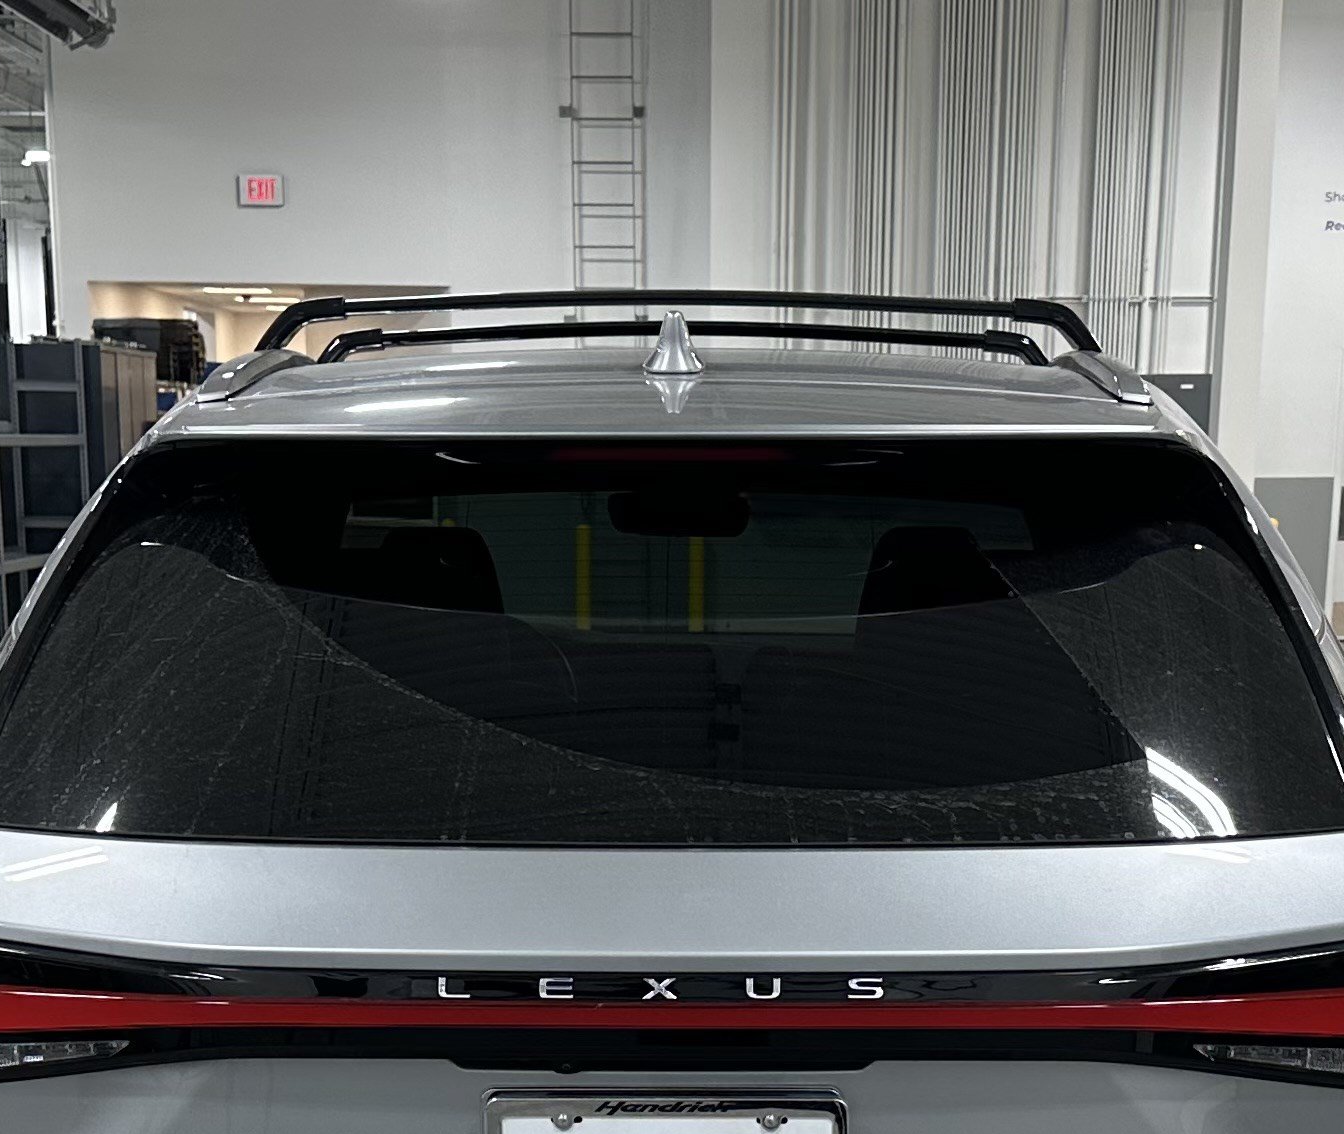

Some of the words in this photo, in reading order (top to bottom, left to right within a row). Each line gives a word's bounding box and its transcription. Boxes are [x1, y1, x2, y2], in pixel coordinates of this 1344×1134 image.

[248, 177, 275, 200] EXIT
[438, 977, 884, 999] LEXUS
[595, 1101, 735, 1116] Hendrick
